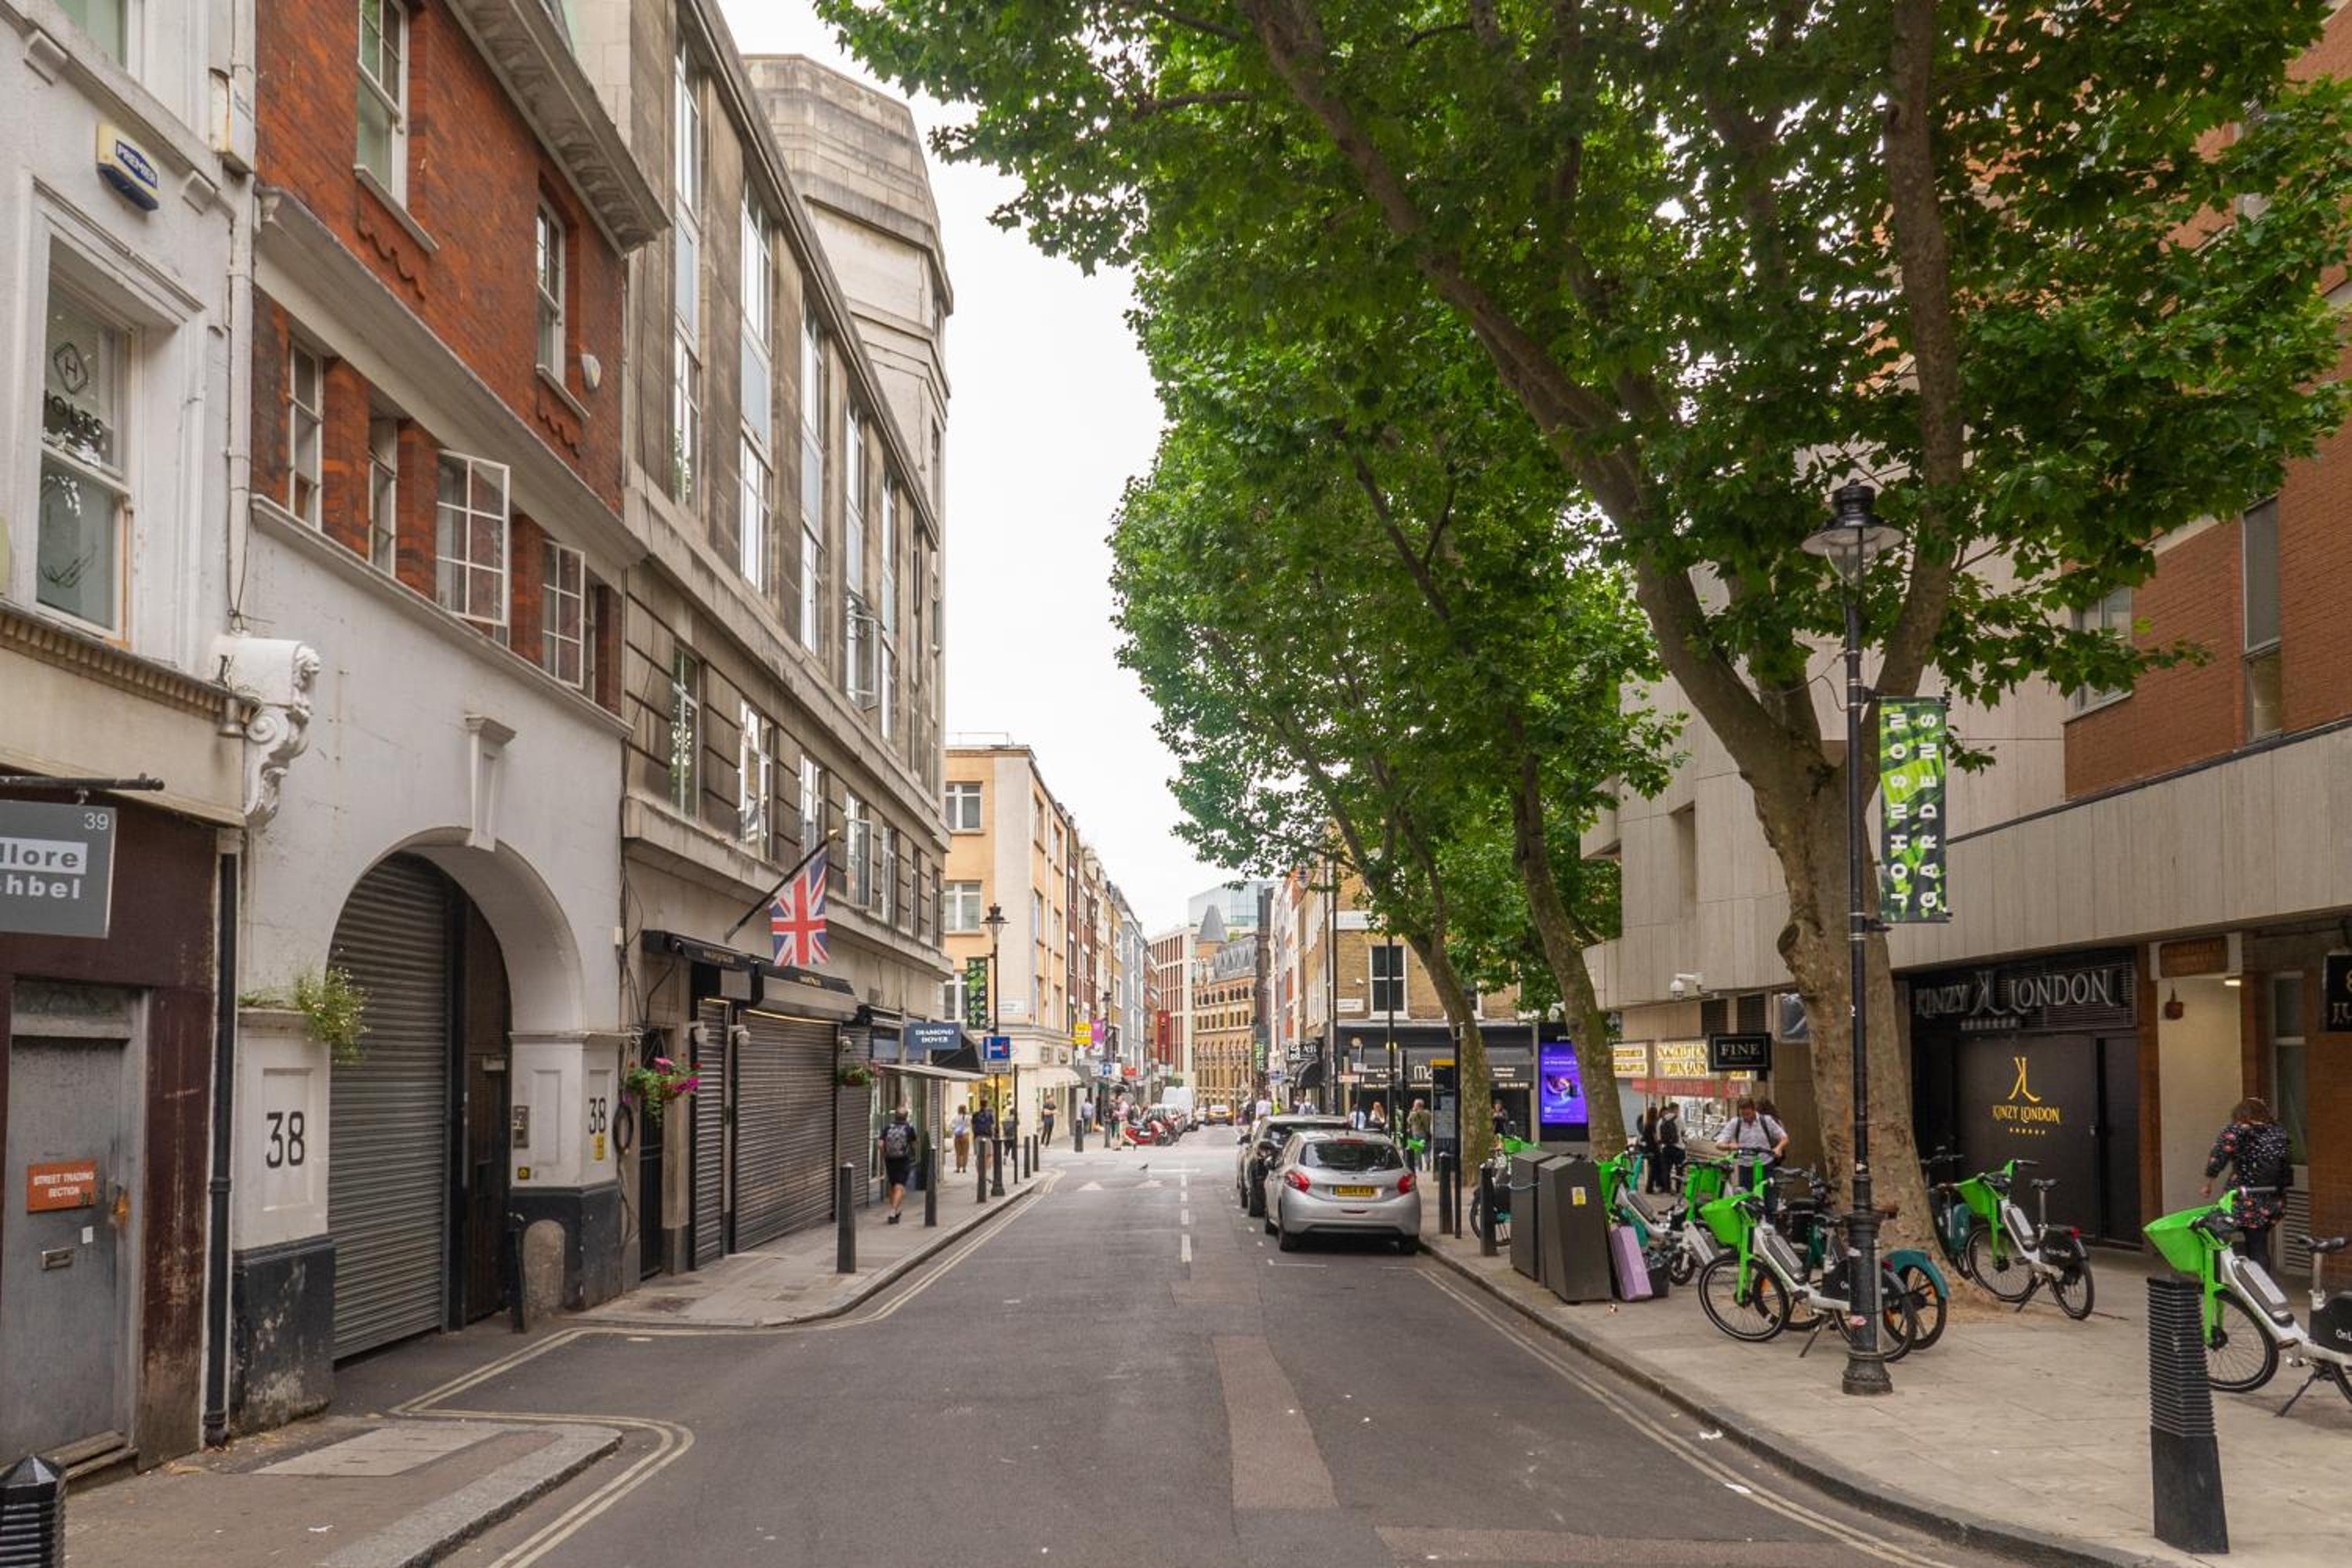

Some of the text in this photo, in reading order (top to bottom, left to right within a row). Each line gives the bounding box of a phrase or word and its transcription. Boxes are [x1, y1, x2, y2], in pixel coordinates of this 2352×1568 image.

[83, 812, 109, 830] 39
[1890, 713, 1907, 905] JOHNSON
[1920, 713, 1937, 909] GARDENS
[2009, 969, 2114, 1014] LONDON
[1720, 1044, 1761, 1056] FINE
[590, 1097, 606, 1134] 38
[1993, 1105, 2060, 1124] KINZY LONDON
[266, 1111, 305, 1168] 38
